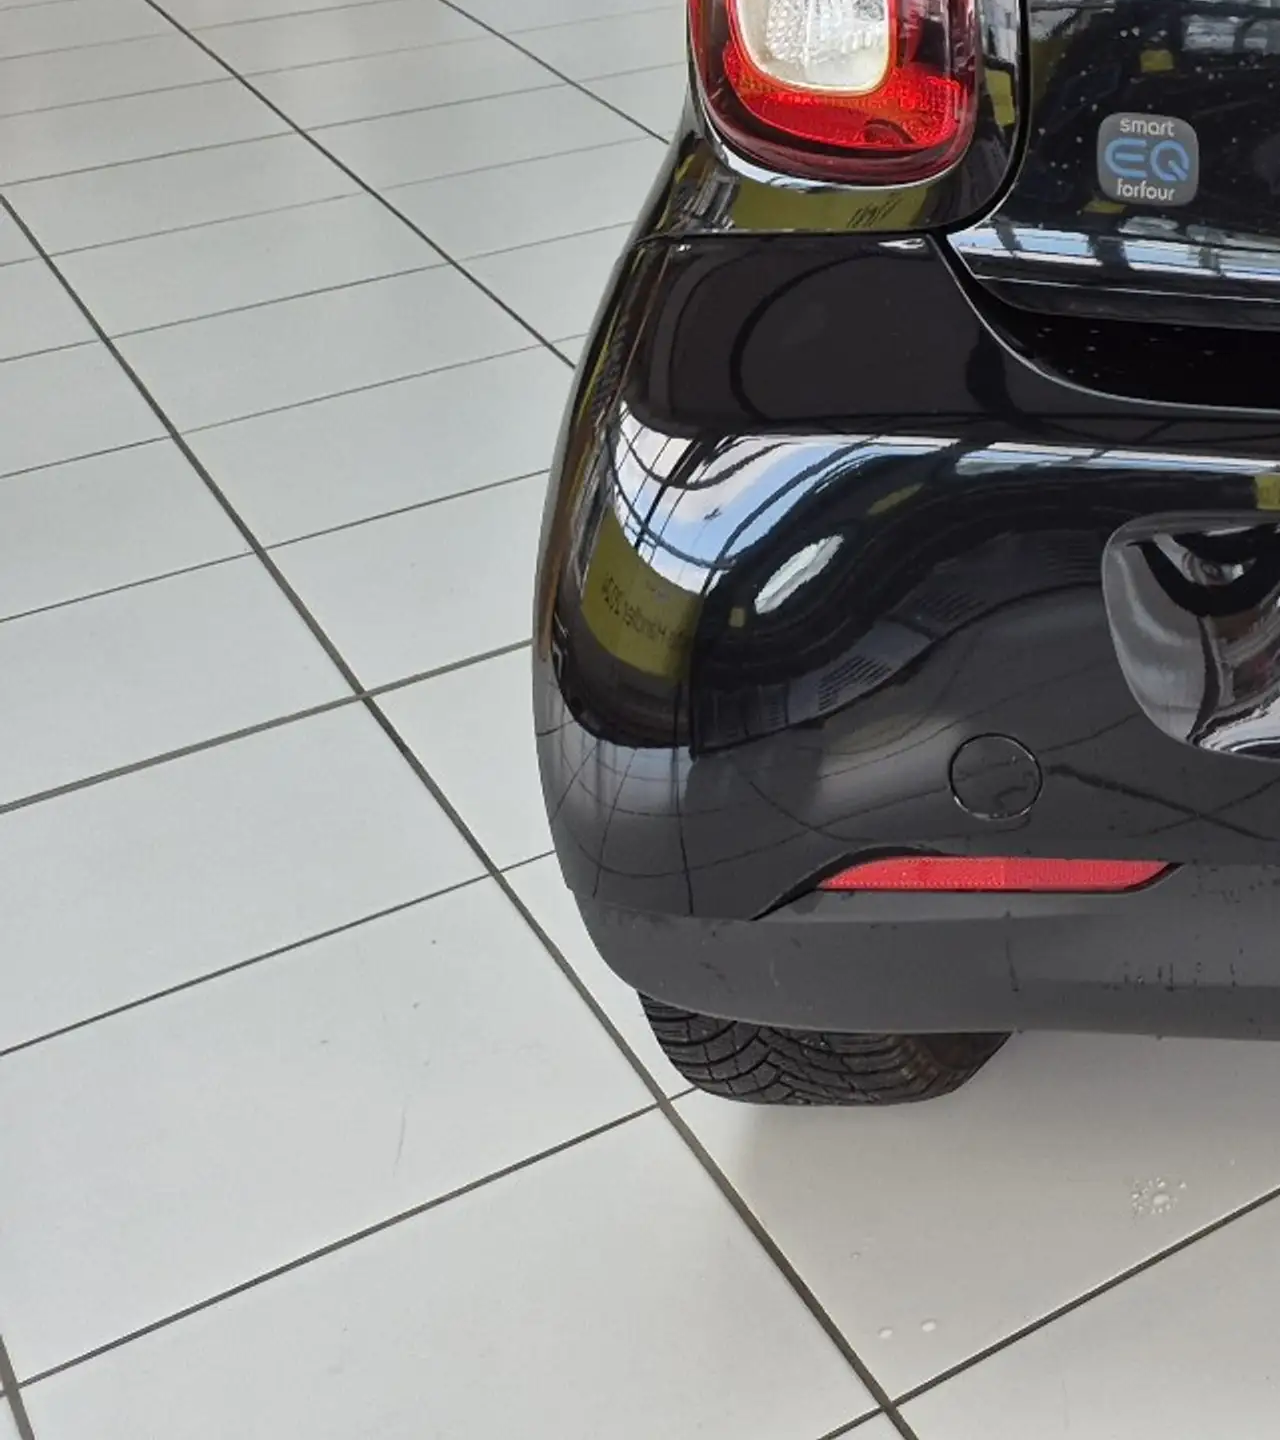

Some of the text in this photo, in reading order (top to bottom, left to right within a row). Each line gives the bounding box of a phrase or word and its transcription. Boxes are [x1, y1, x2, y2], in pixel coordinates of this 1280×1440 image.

[1119, 117, 1176, 138] smart
[1104, 137, 1190, 181] EQ
[1116, 177, 1176, 201] forfour
